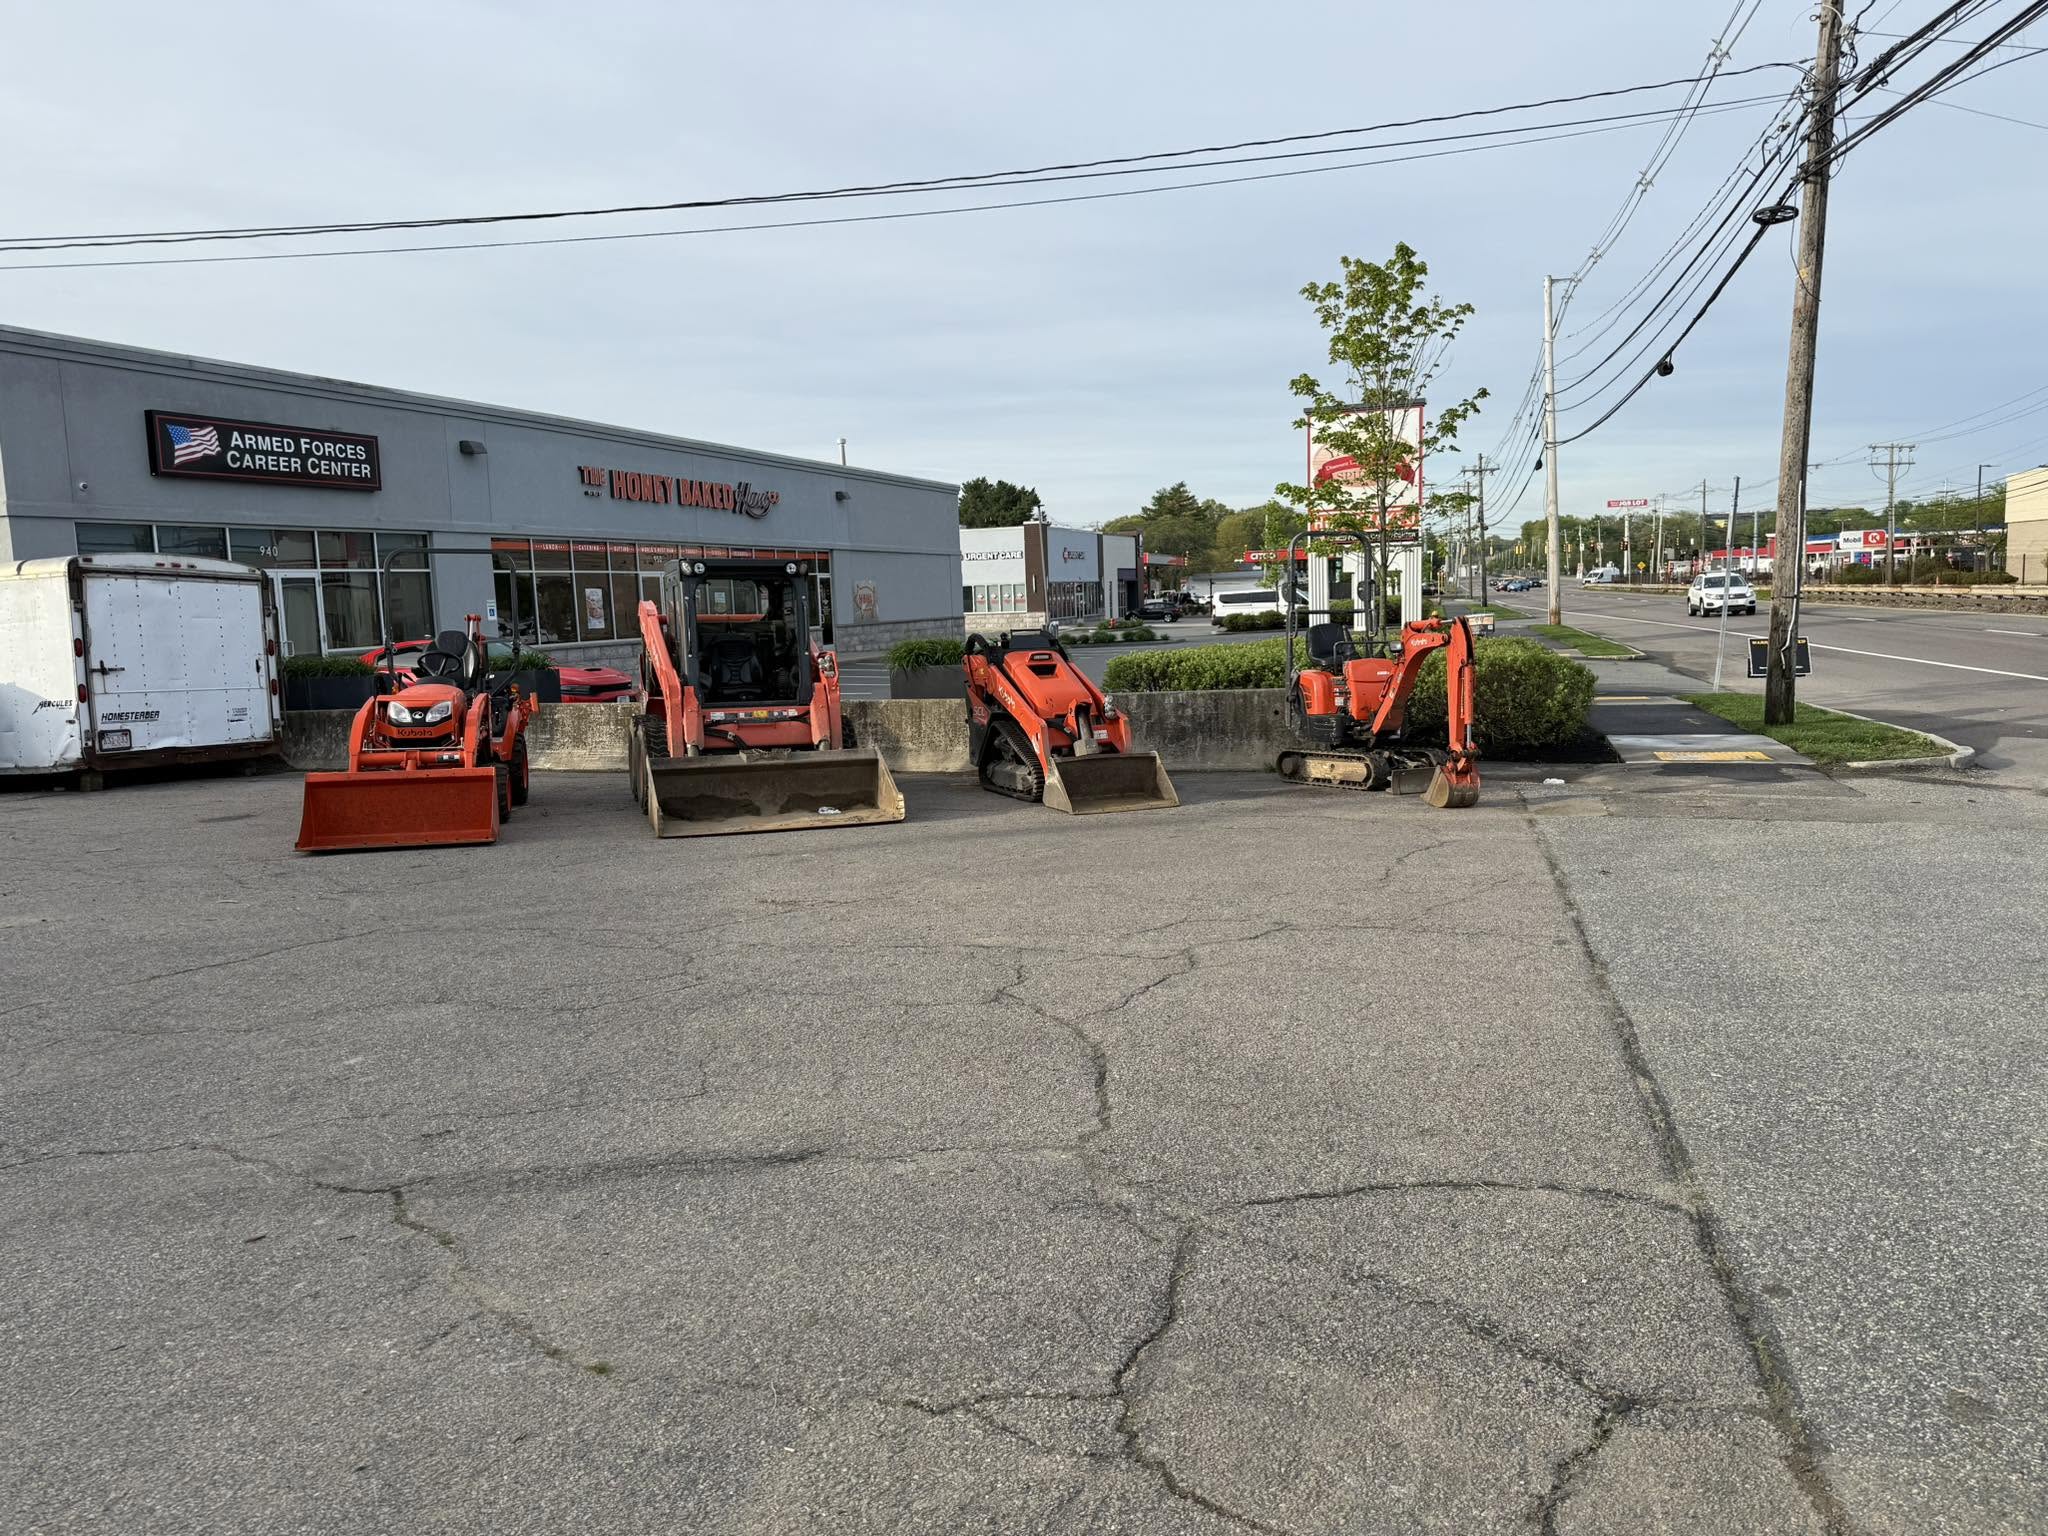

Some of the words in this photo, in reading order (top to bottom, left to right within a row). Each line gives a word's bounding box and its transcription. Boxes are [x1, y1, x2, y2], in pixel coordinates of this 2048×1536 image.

[231, 431, 295, 453] ARMED
[300, 438, 366, 460] FORCES
[227, 451, 301, 473] CAREER
[307, 458, 371, 478] CENTER
[578, 466, 607, 486] THE
[610, 469, 674, 503] HONEY
[678, 478, 735, 511] BAKED
[260, 545, 278, 556] 940
[964, 552, 998, 560] URGENT
[1000, 551, 1023, 560] CARE
[32, 700, 73, 715] HERCULES
